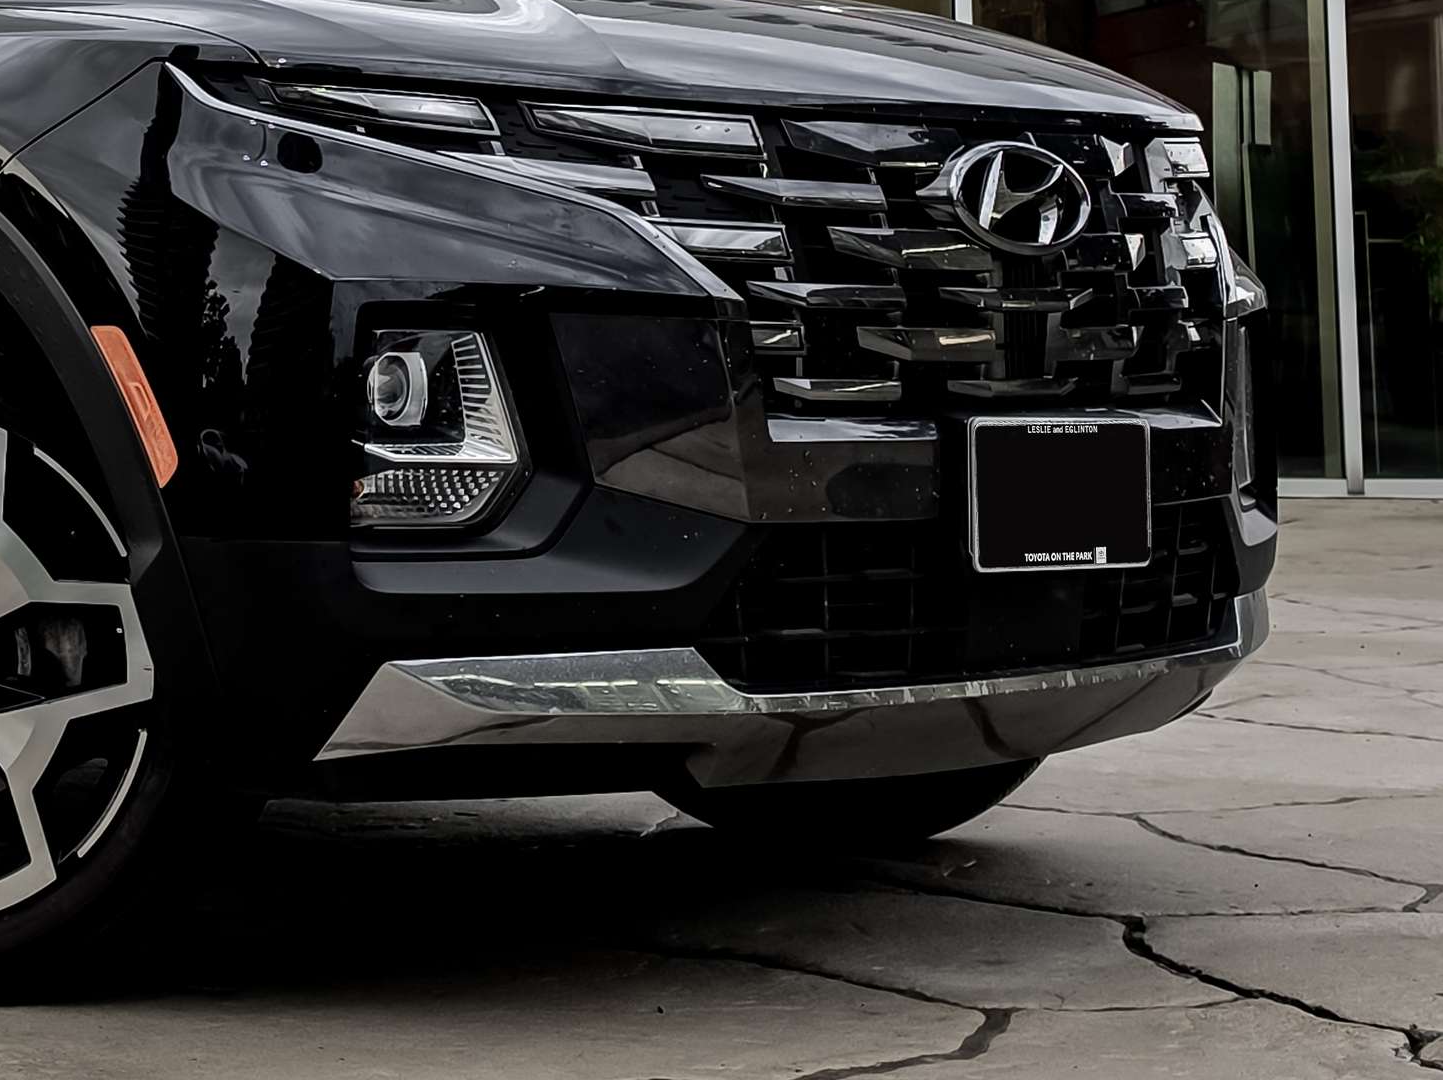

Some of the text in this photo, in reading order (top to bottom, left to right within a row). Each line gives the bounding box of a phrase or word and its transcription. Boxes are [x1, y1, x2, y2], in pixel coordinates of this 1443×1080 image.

[1027, 425, 1098, 434] LESLIE and EGLINTON
[1024, 552, 1051, 562] TOYOTA
[1050, 552, 1062, 562] ON
[1062, 552, 1075, 561] THE
[1075, 551, 1093, 560] PARK
